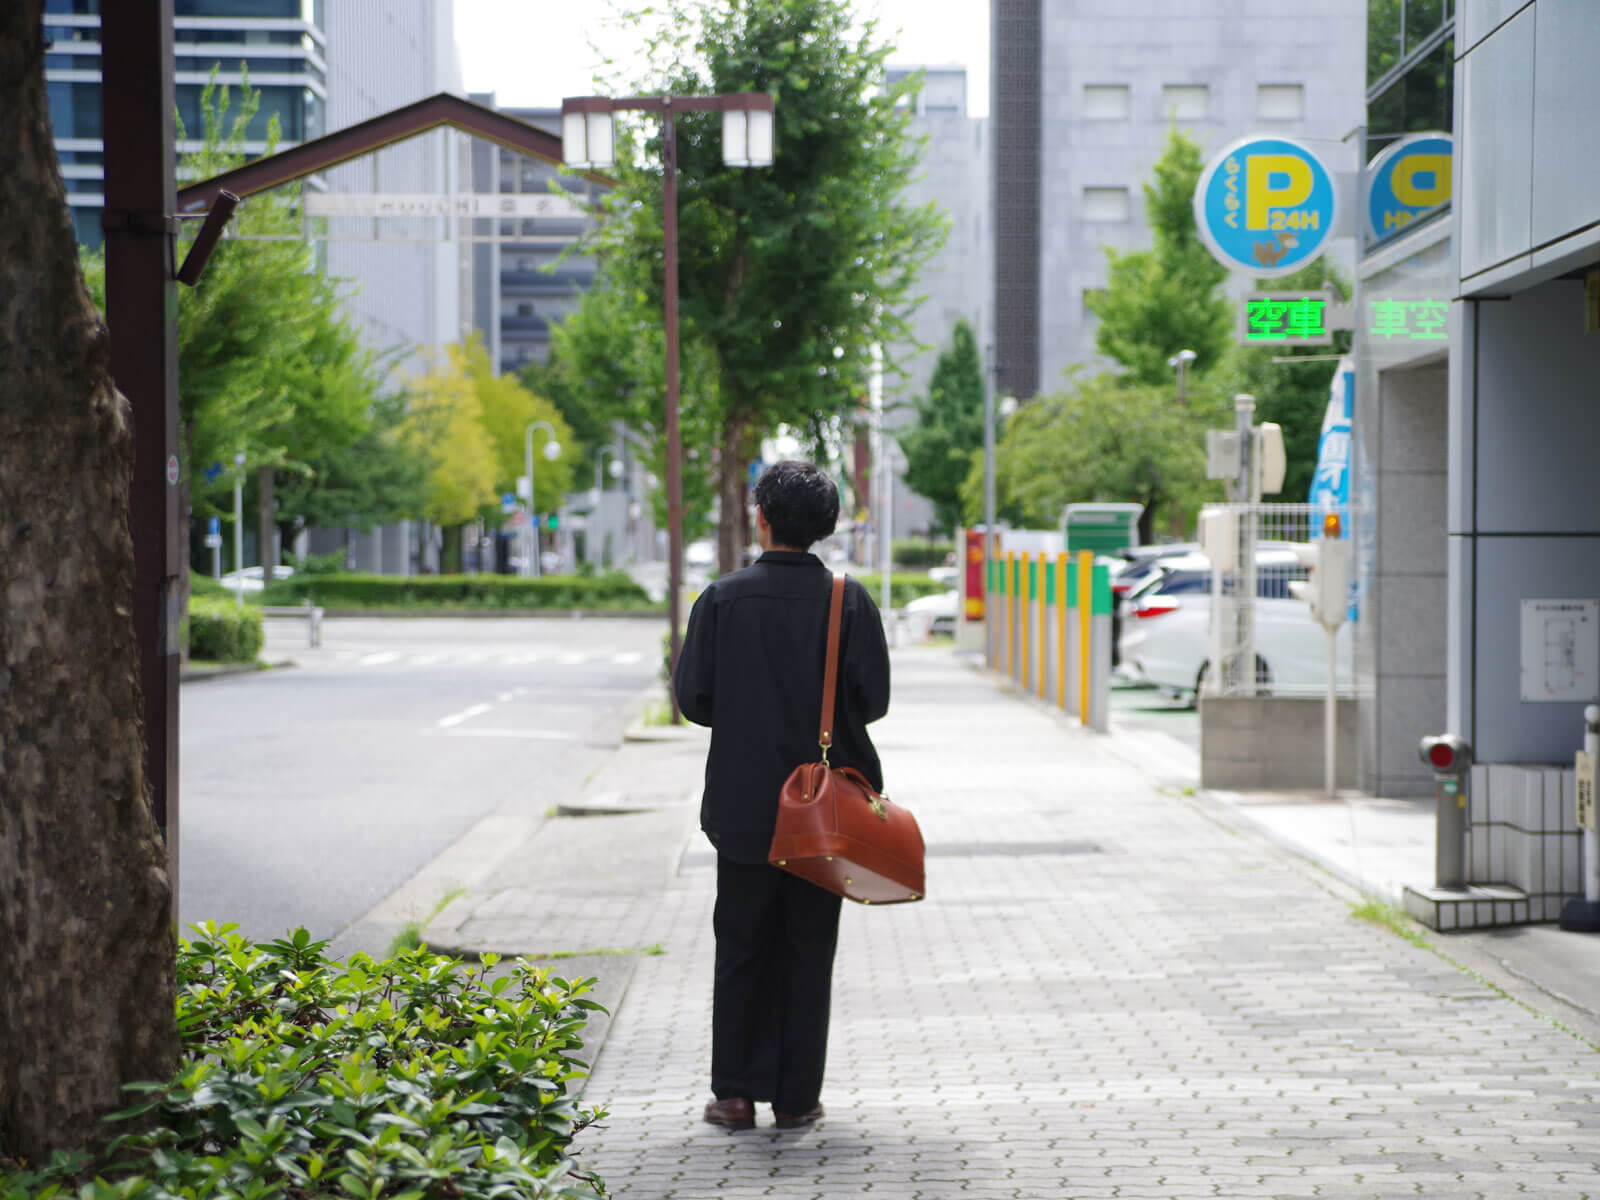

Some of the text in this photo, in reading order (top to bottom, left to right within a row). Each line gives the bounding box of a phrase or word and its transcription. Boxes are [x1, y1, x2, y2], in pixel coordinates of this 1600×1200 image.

[1224, 156, 1240, 229] らくらく
[1247, 154, 1313, 230] P
[1270, 210, 1319, 230] 24H
[1247, 297, 1325, 339] 空車
